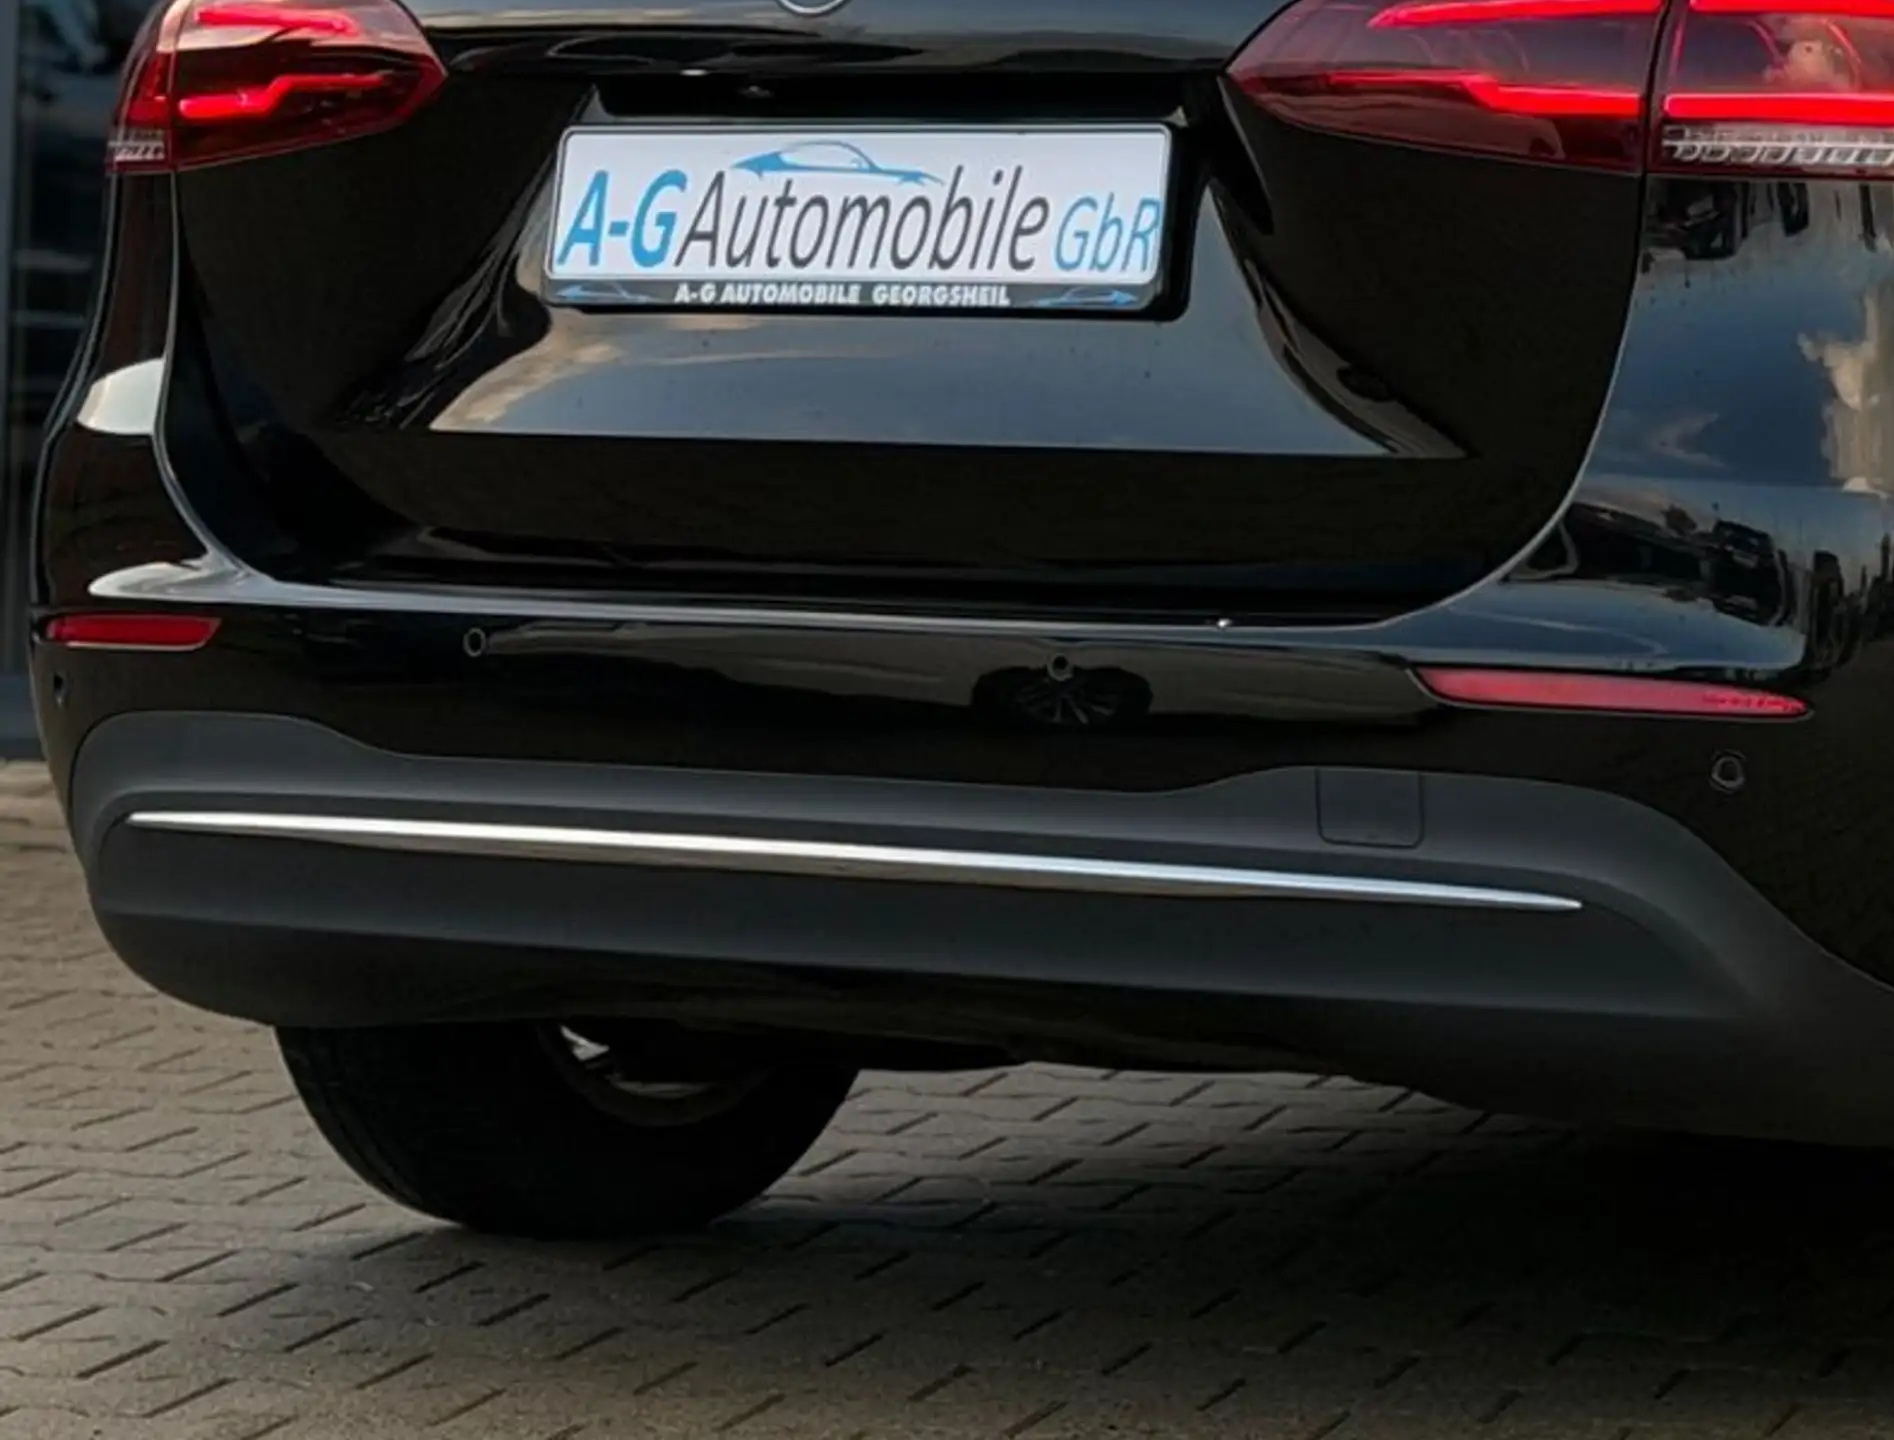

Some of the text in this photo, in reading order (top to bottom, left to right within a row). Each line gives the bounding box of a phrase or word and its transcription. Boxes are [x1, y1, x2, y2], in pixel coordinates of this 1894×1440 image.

[556, 164, 1161, 273] A-G Automobile GbR
[674, 283, 1011, 308] A-G AUTOMOBILE GEORGSHEIL
